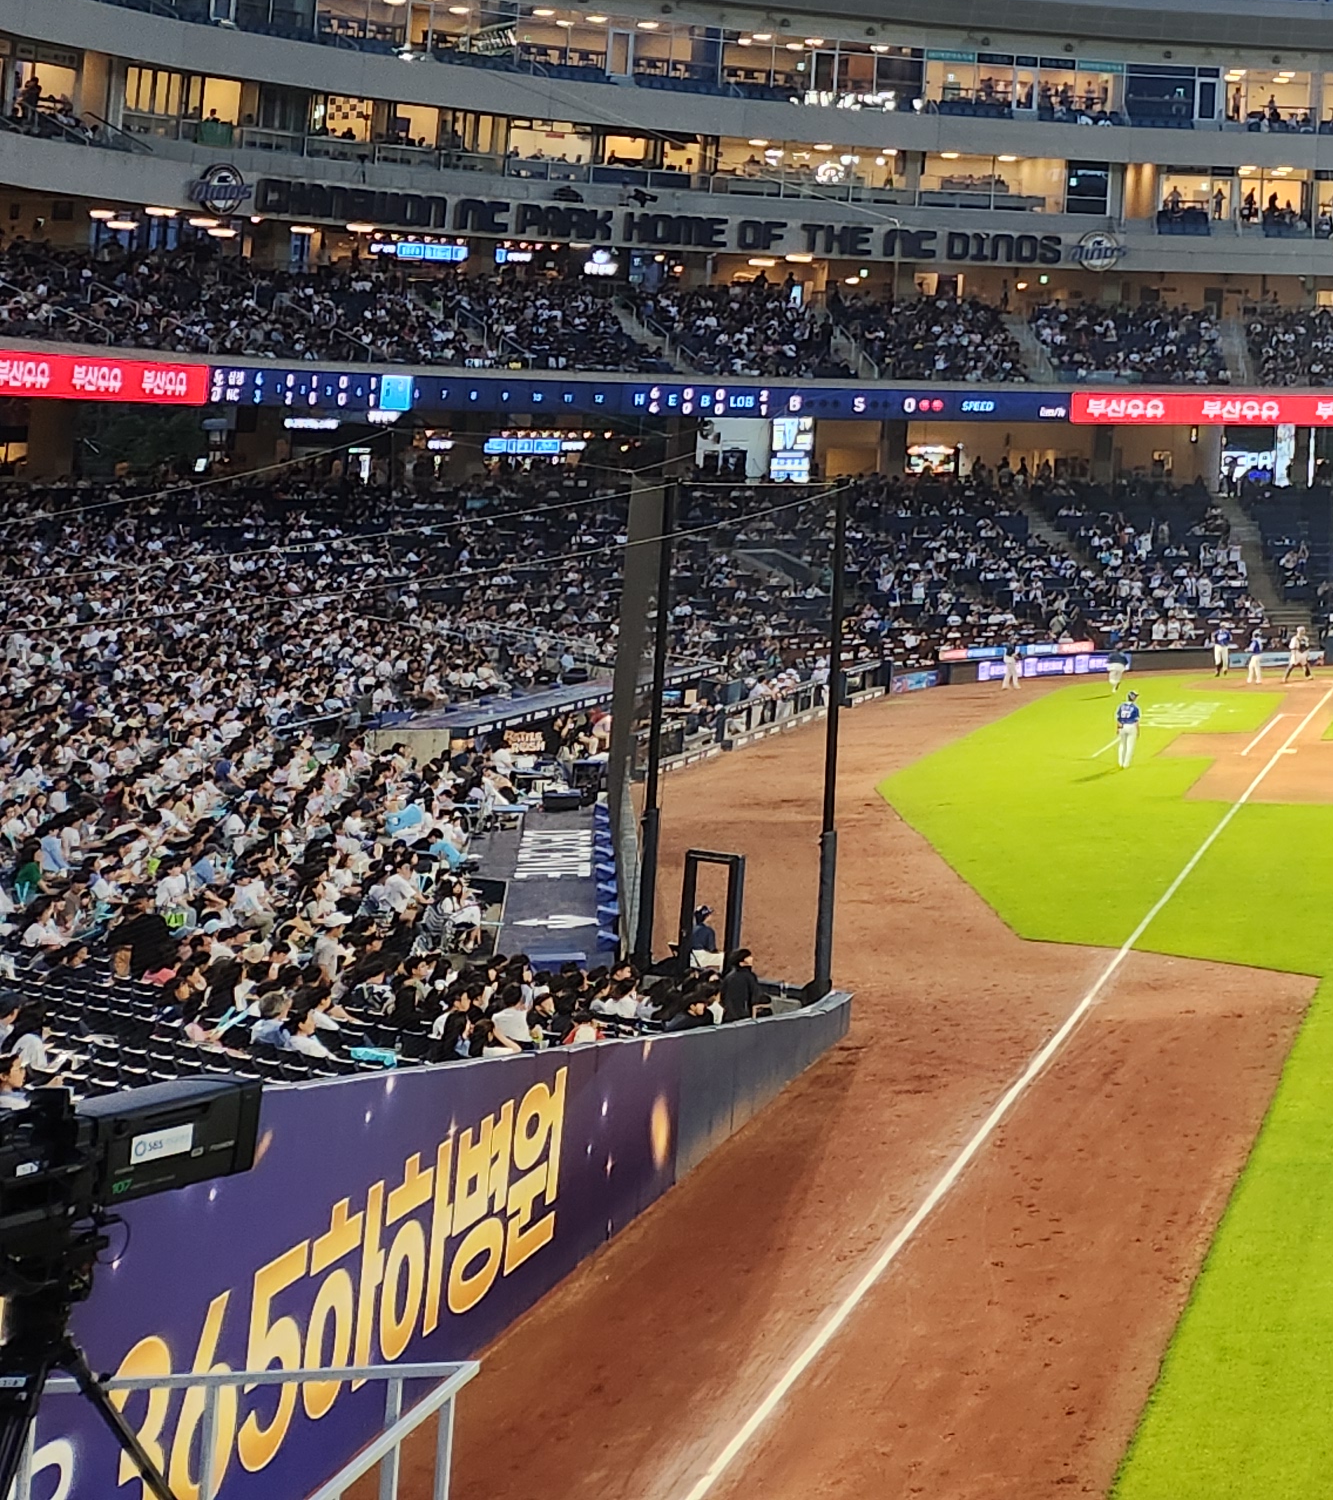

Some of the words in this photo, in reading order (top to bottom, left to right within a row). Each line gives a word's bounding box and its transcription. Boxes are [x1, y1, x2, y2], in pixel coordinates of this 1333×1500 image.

[453, 199, 510, 233] NC
[515, 203, 613, 241] PARK
[623, 211, 728, 248] HOME
[737, 219, 788, 250] OF
[801, 223, 873, 256] THE
[883, 229, 937, 258] NC
[946, 232, 1061, 263] DINOS
[0, 360, 50, 388] 부산우유
[72, 365, 122, 393] 부산우유
[142, 370, 187, 396] 부산우유
[286, 373, 295, 388] 0
[311, 375, 319, 388] 1
[339, 375, 348, 389] 0
[370, 377, 377, 390] 1
[650, 387, 660, 399] 6
[683, 387, 694, 400] 0
[716, 388, 725, 401] 0
[760, 390, 769, 402] 2
[226, 388, 240, 402] NC
[285, 391, 293, 405] 2
[309, 391, 318, 405] 0
[338, 392, 348, 406] 0
[369, 393, 376, 407] 1
[682, 401, 693, 414] 0
[714, 402, 724, 415] 0
[760, 404, 767, 417] 1
[564, 394, 572, 403] 11
[595, 394, 604, 403] 12
[634, 394, 645, 405] H
[668, 394, 677, 406] E
[701, 395, 711, 407] B
[730, 395, 755, 408] LOB
[789, 395, 802, 411] B
[854, 397, 865, 412] S
[961, 400, 995, 412] SPEED
[1087, 399, 1165, 419] 부산우유
[1202, 400, 1279, 420] 부산우유
